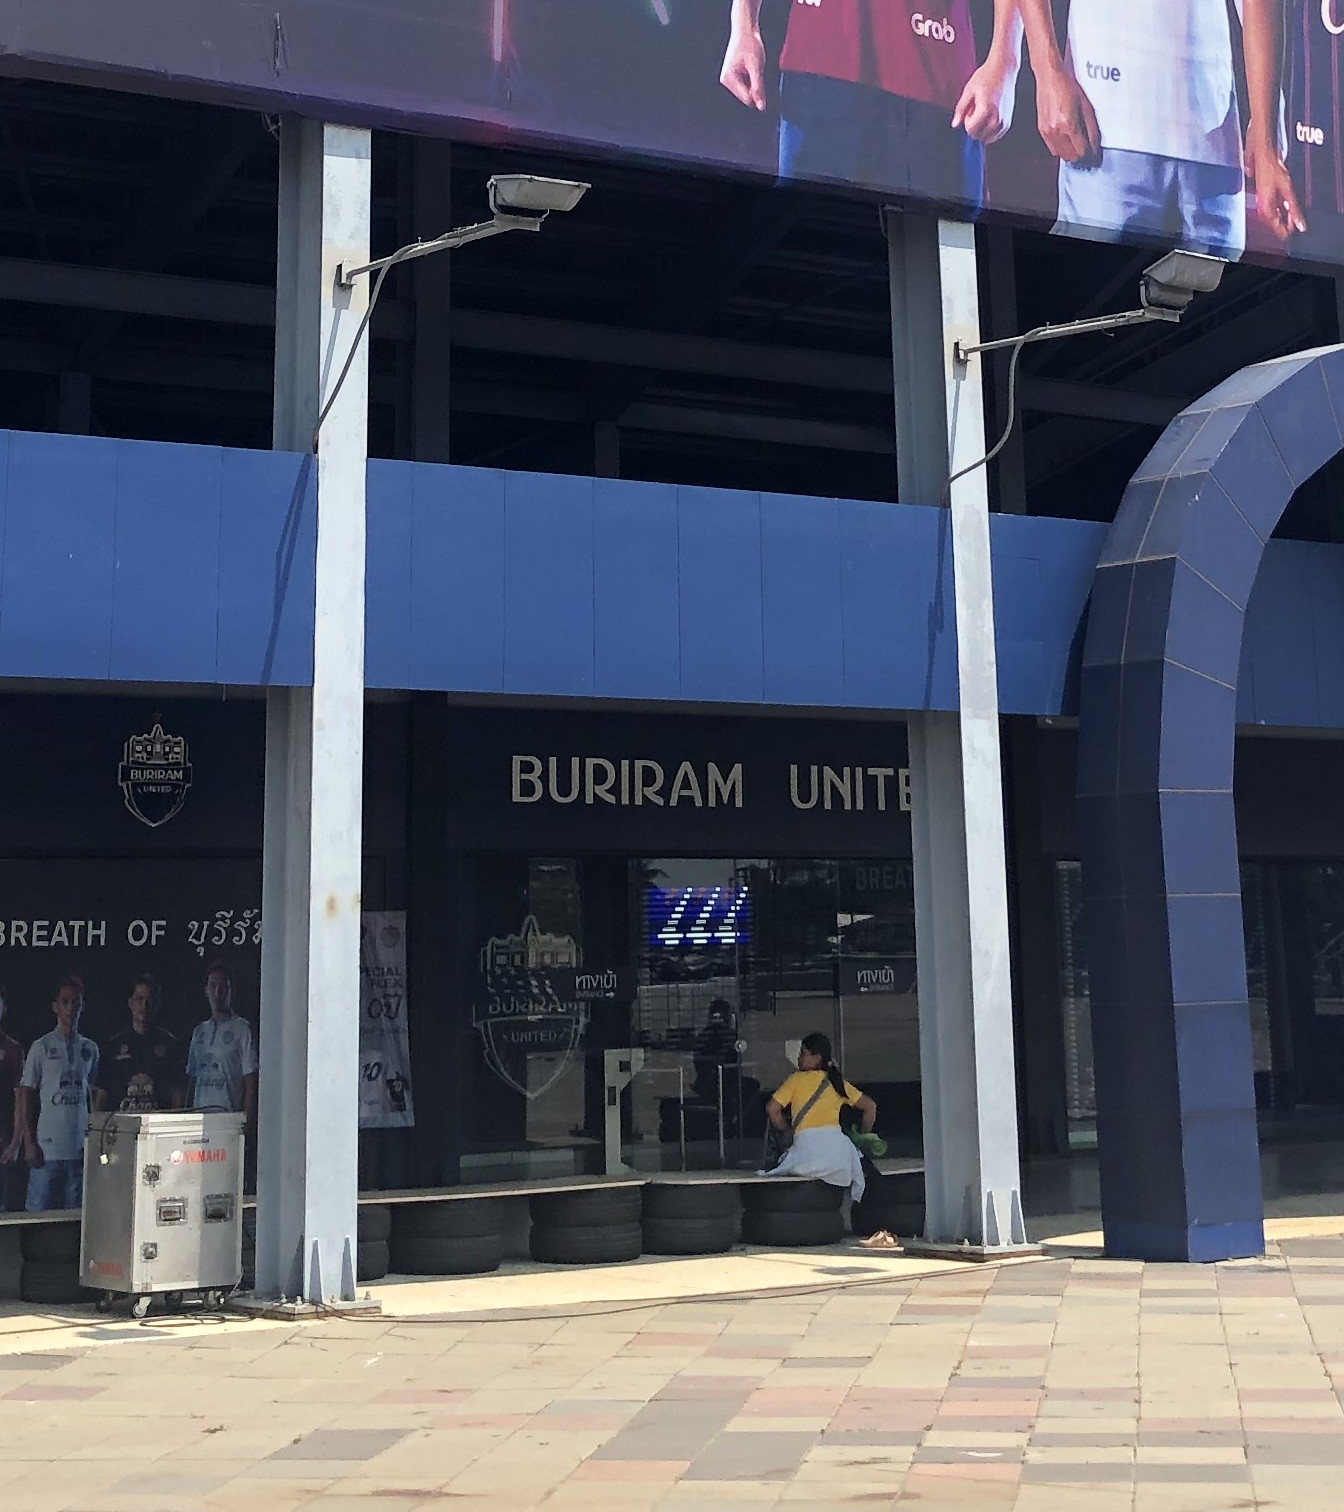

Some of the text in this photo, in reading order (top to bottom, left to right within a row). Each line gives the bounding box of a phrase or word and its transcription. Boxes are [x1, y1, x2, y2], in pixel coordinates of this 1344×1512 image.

[911, 13, 955, 43] Grab
[1086, 61, 1121, 81] true
[1296, 121, 1324, 145] true
[130, 769, 183, 780] BURIRAM
[511, 755, 743, 808] BURIRAM
[127, 919, 167, 947] OF
